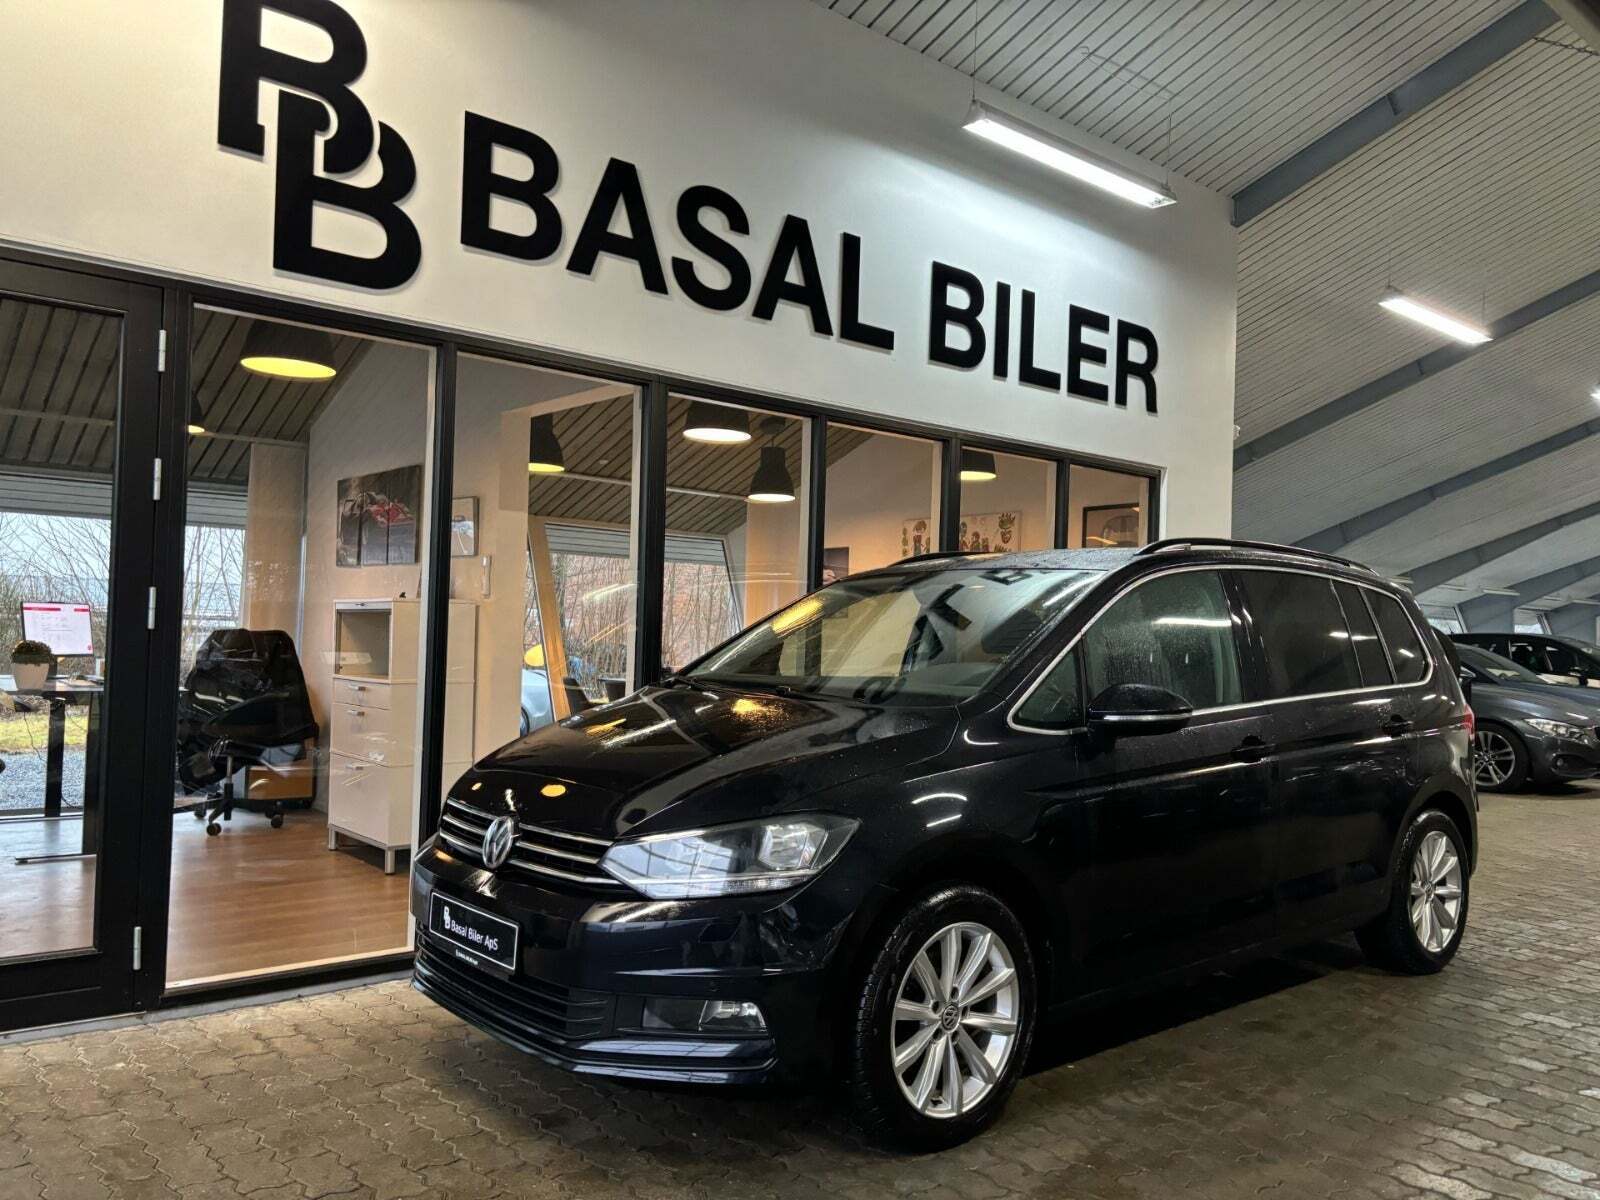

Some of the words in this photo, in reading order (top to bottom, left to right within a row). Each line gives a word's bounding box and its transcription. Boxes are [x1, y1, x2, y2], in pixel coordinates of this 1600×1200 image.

[461, 110, 895, 351] BASAL
[929, 261, 1158, 413] BILER
[451, 920, 467, 937] Basal
[468, 928, 483, 944] Biler
[484, 938, 498, 951] ApS
